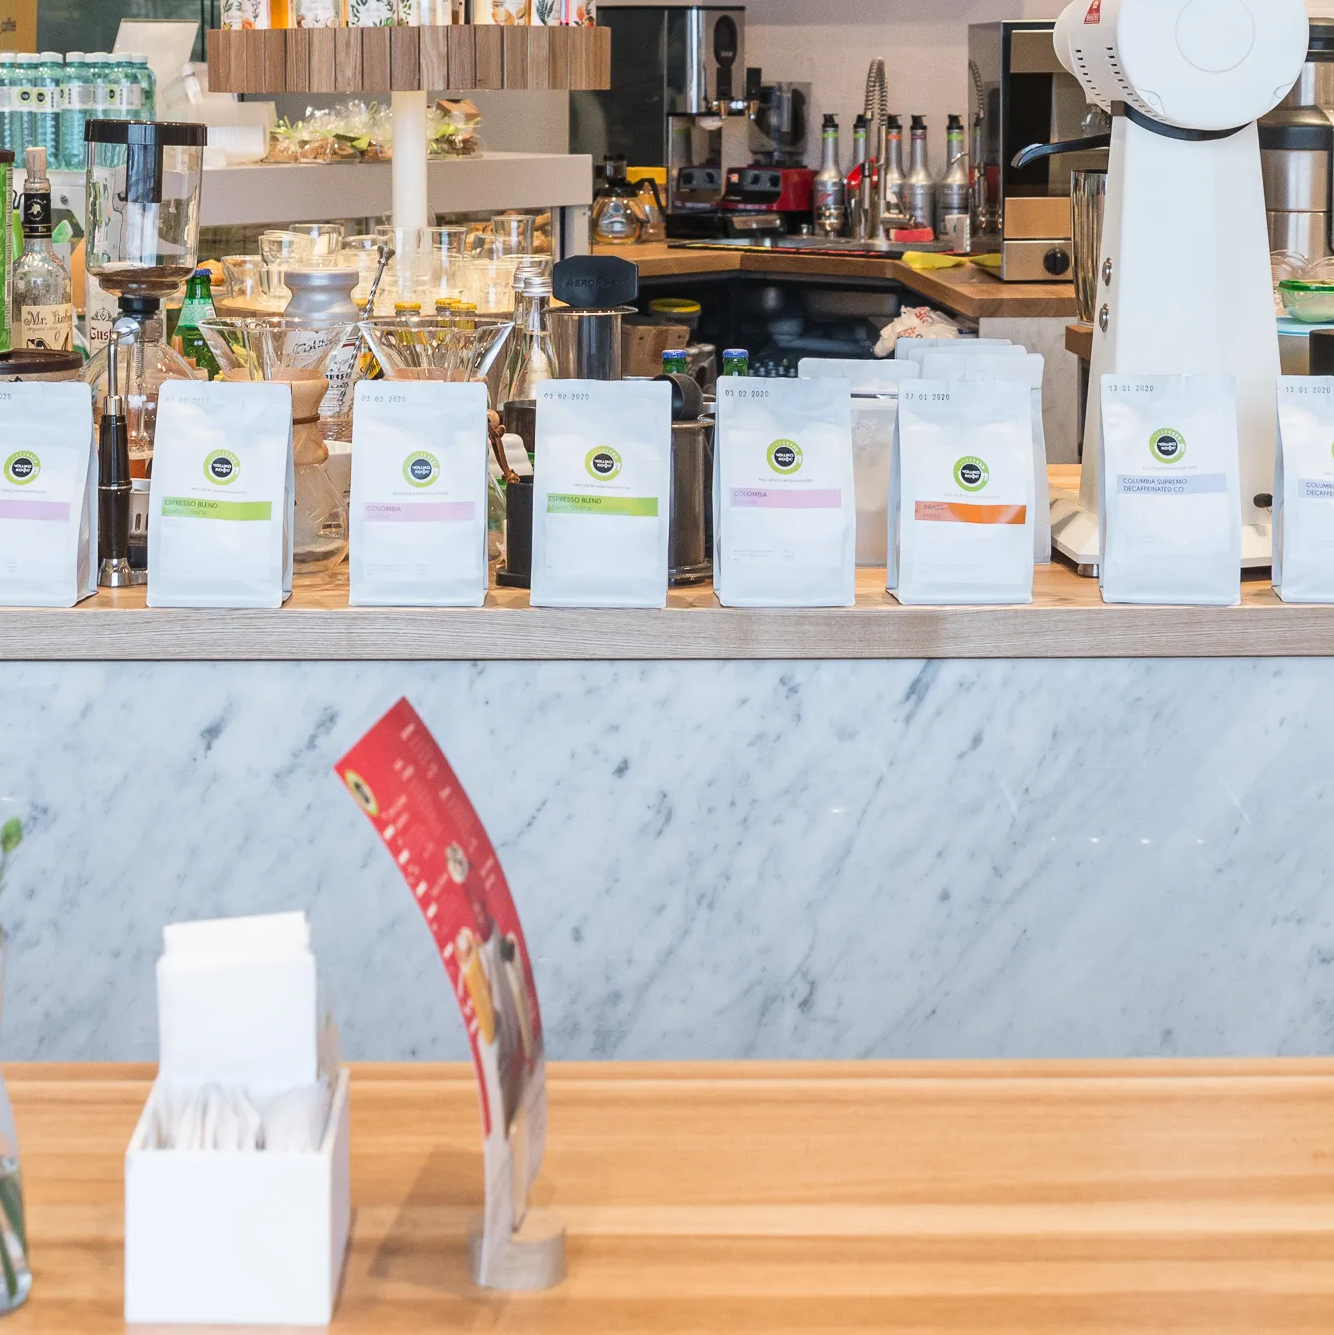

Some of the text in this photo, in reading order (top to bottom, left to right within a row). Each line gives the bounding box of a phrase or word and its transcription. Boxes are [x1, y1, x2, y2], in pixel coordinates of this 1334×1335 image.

[725, 389, 769, 398] 03 02 2020
[1285, 386, 1331, 394] 13 01 2020
[388, 395, 406, 403] 2020
[571, 393, 590, 401] 2020
[905, 392, 950, 401] 27 01 2020
[1123, 477, 1188, 486] COLUMBIA SUPREMO
[1123, 485, 1185, 493] DECAFFEINATED CO
[548, 495, 580, 504] ESPRESSO
[164, 499, 218, 509] ESPRESSO BLEND
[366, 505, 402, 513] COLOMBIA
